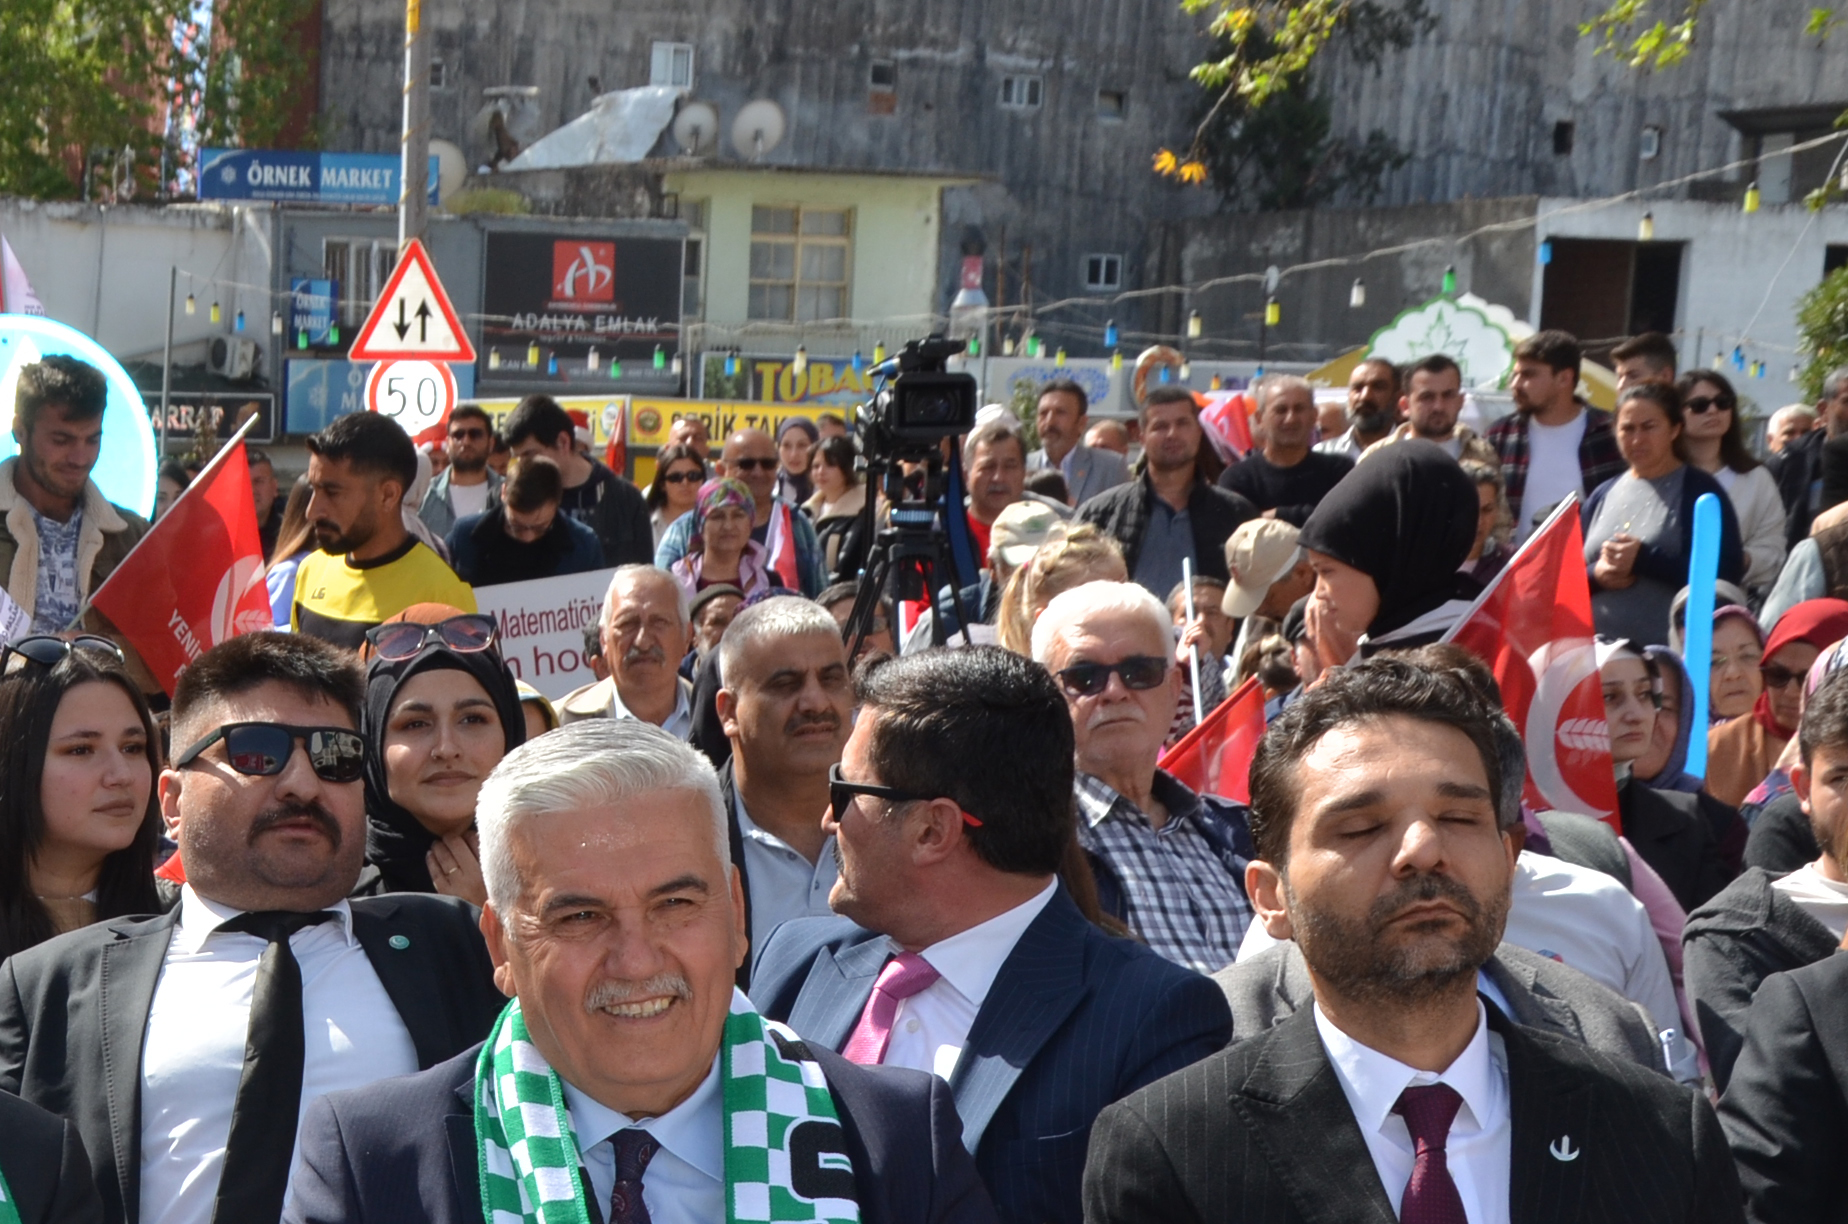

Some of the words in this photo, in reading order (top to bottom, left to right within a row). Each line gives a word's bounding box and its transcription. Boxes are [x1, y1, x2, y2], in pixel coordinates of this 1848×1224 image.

[247, 160, 311, 187] ÖRNEK
[320, 168, 393, 189] MARKET
[294, 314, 328, 329] MARKET
[511, 312, 586, 331] ADALYA
[594, 315, 659, 335] EMLAK
[387, 376, 438, 418] 50
